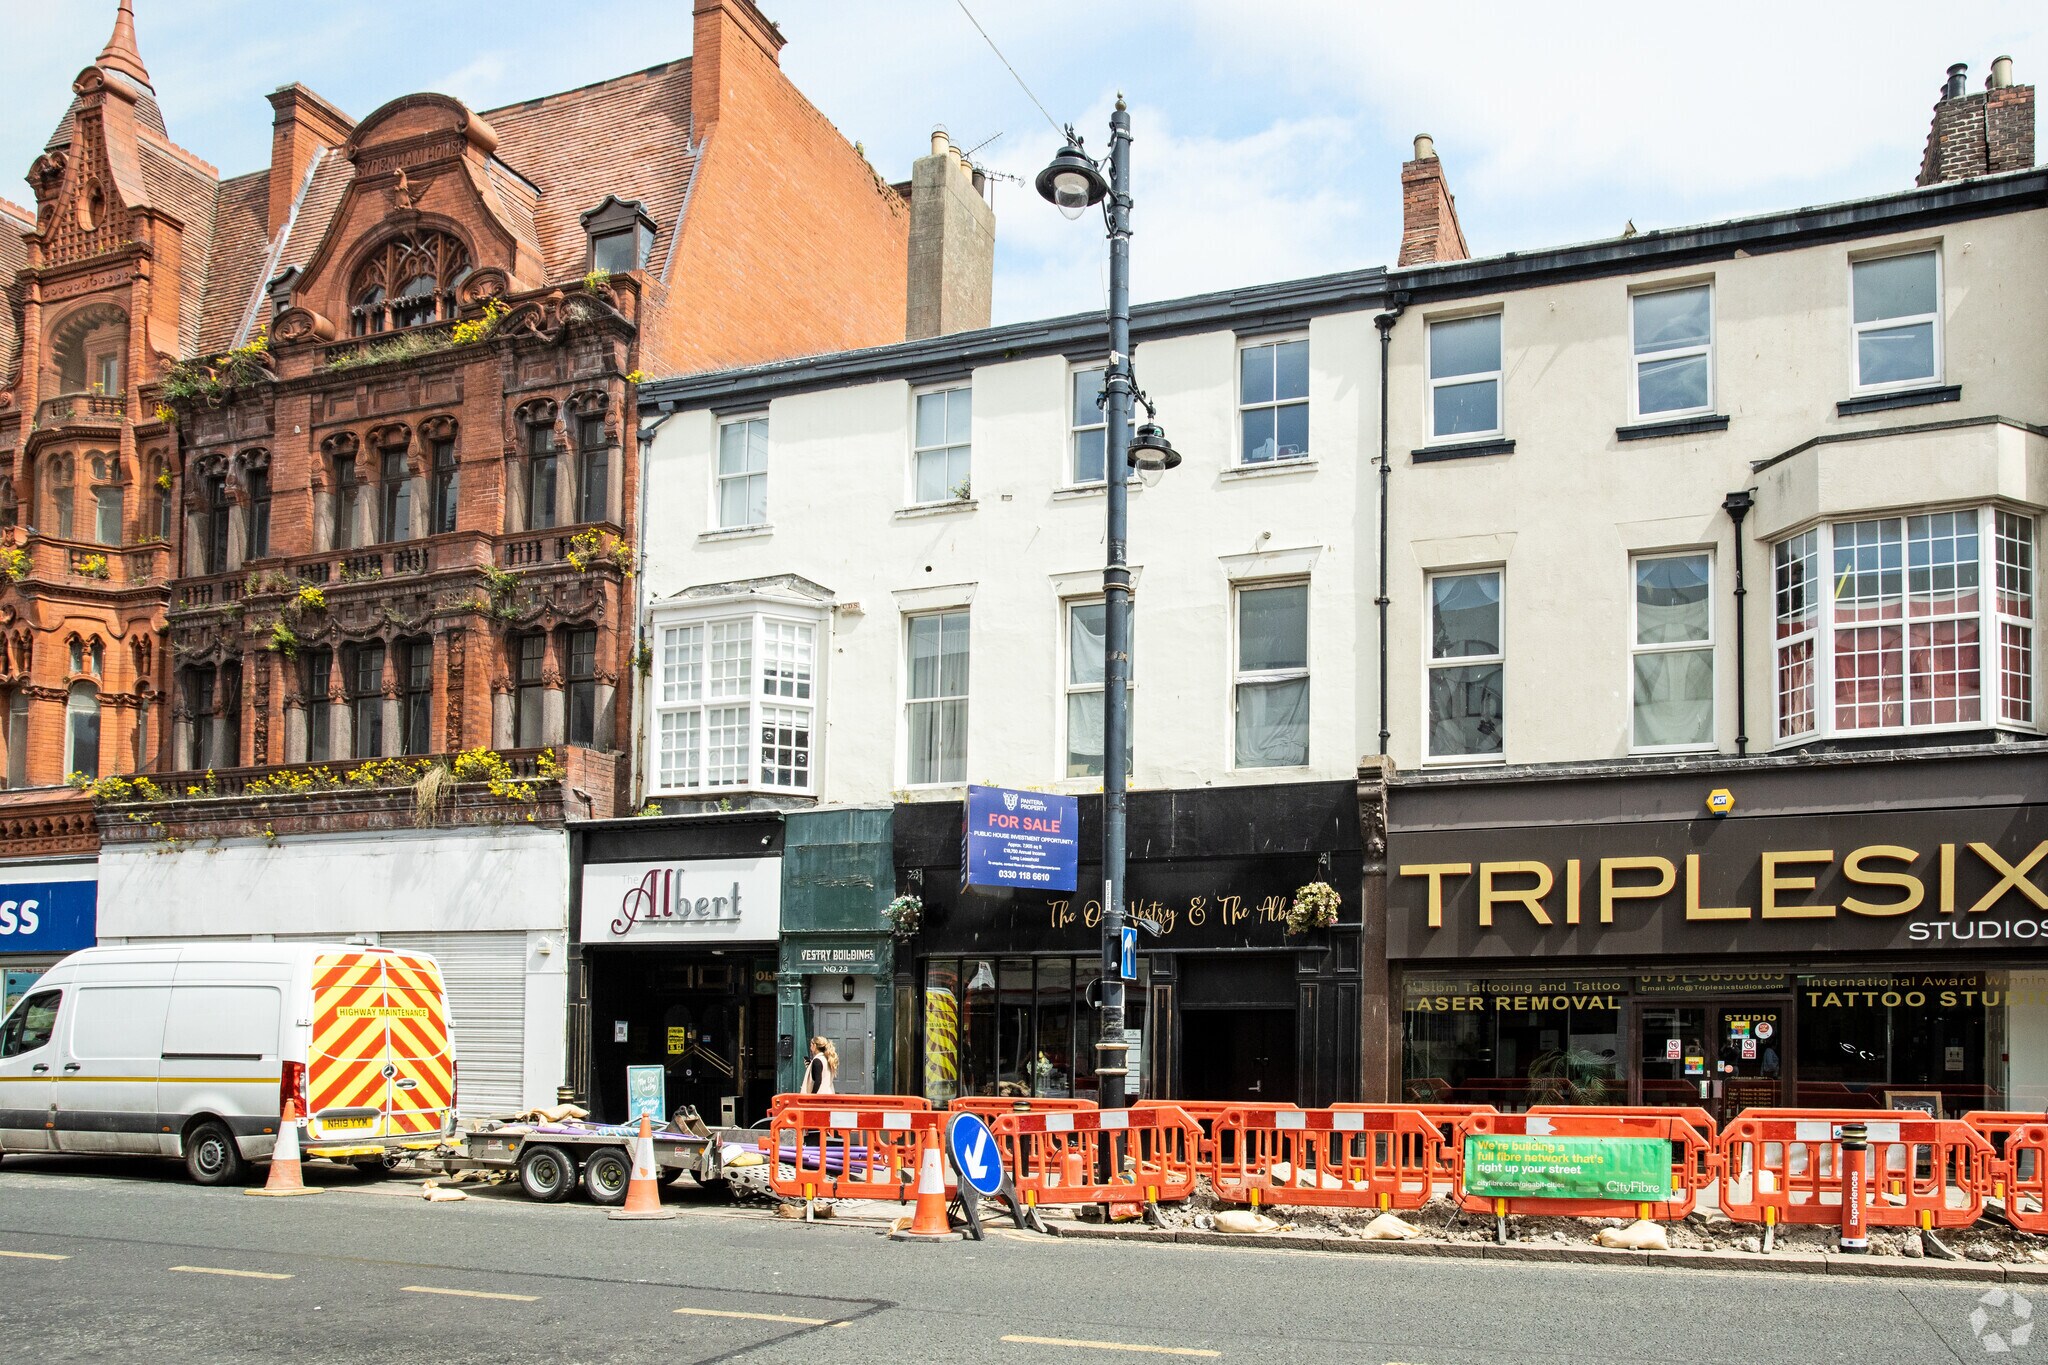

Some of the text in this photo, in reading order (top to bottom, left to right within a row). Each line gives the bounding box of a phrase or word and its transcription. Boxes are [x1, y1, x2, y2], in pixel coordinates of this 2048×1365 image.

[1020, 798, 1044, 806] PANTERA
[1020, 804, 1047, 812] PROPERTY
[988, 813, 1060, 833] FOR SALE
[973, 830, 992, 838] PUBLIC
[1010, 834, 1040, 842] INVESTMENT
[1040, 837, 1074, 845] OPPORTUNITY
[998, 869, 1050, 881] 0330 118 6610
[1400, 843, 2048, 927] TRIPLESIX
[611, 869, 741, 934] The Albert
[1047, 899, 1077, 928] The
[1131, 899, 1179, 934] Vestry
[1188, 896, 1206, 926] &
[1217, 896, 1250, 925] The
[1256, 896, 1294, 924] Albe
[801, 949, 874, 961] VESTRY BUILDINGS
[1405, 981, 1621, 993] ustom Tattooing and Tattoo
[1668, 983, 1785, 992] info@Triplesixstudios.com
[1806, 977, 1915, 987] International
[1922, 976, 1976, 986] Award
[1496, 995, 1622, 1011] REMOVAL
[1806, 991, 1926, 1007] TATTOO
[339, 1008, 427, 1017] HIGHWAY MAINTENANCE
[327, 1119, 348, 1128] NH19
[1477, 1140, 1565, 1153] We're building a
[1477, 1152, 1603, 1164] full fibre network that's
[1477, 1162, 1582, 1175] right up your street
[1477, 1180, 1565, 1190] cityfibre.com/gigabit-cities
[1606, 1181, 1660, 1194] CityFibre
[1849, 1170, 1860, 1226] Experiences
